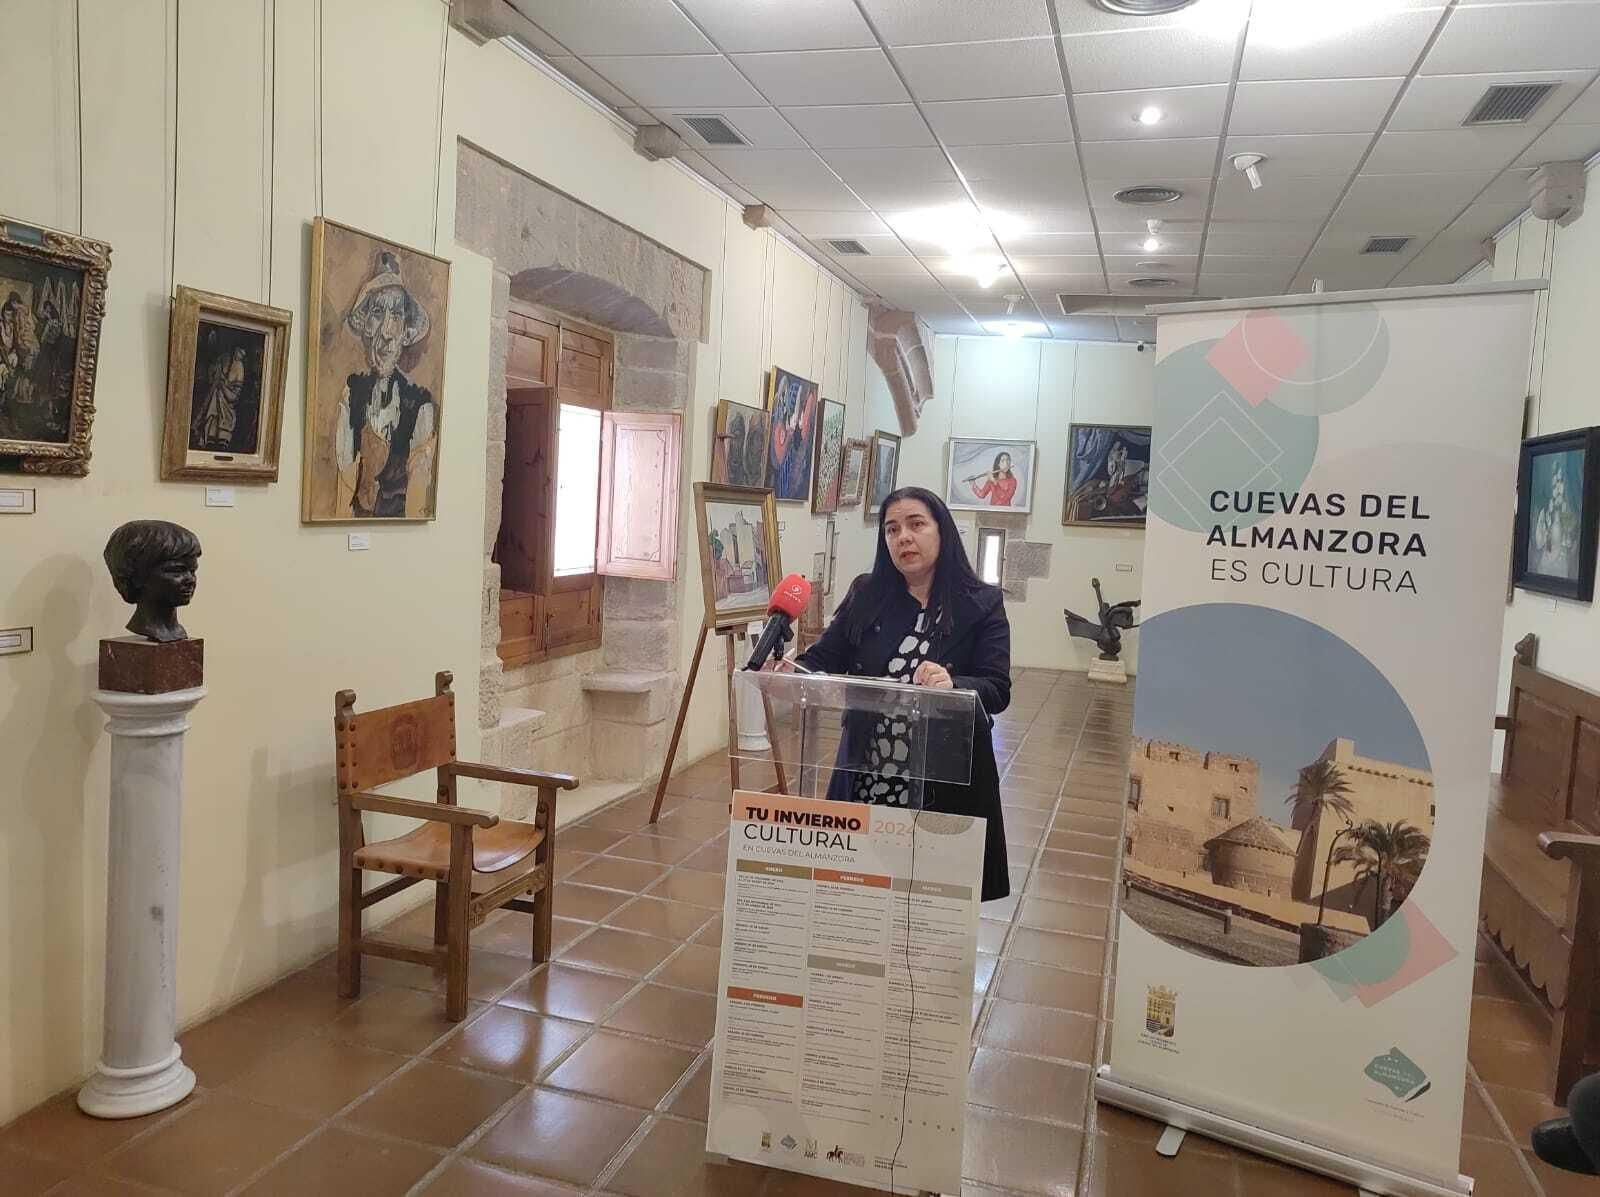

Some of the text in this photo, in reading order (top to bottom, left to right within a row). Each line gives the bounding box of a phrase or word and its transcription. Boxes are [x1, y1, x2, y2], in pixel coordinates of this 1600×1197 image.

[1210, 490, 1431, 520] CUEVAS DEL
[1206, 524, 1427, 557] ALMANZORA
[1210, 558, 1417, 594] ES CULTURA
[745, 806, 861, 831] TU INVIERNO
[744, 823, 858, 852] CULTURAL
[755, 846, 787, 856] CUEVAS
[788, 849, 804, 857] DEL
[805, 850, 856, 863] ALMANZORA
